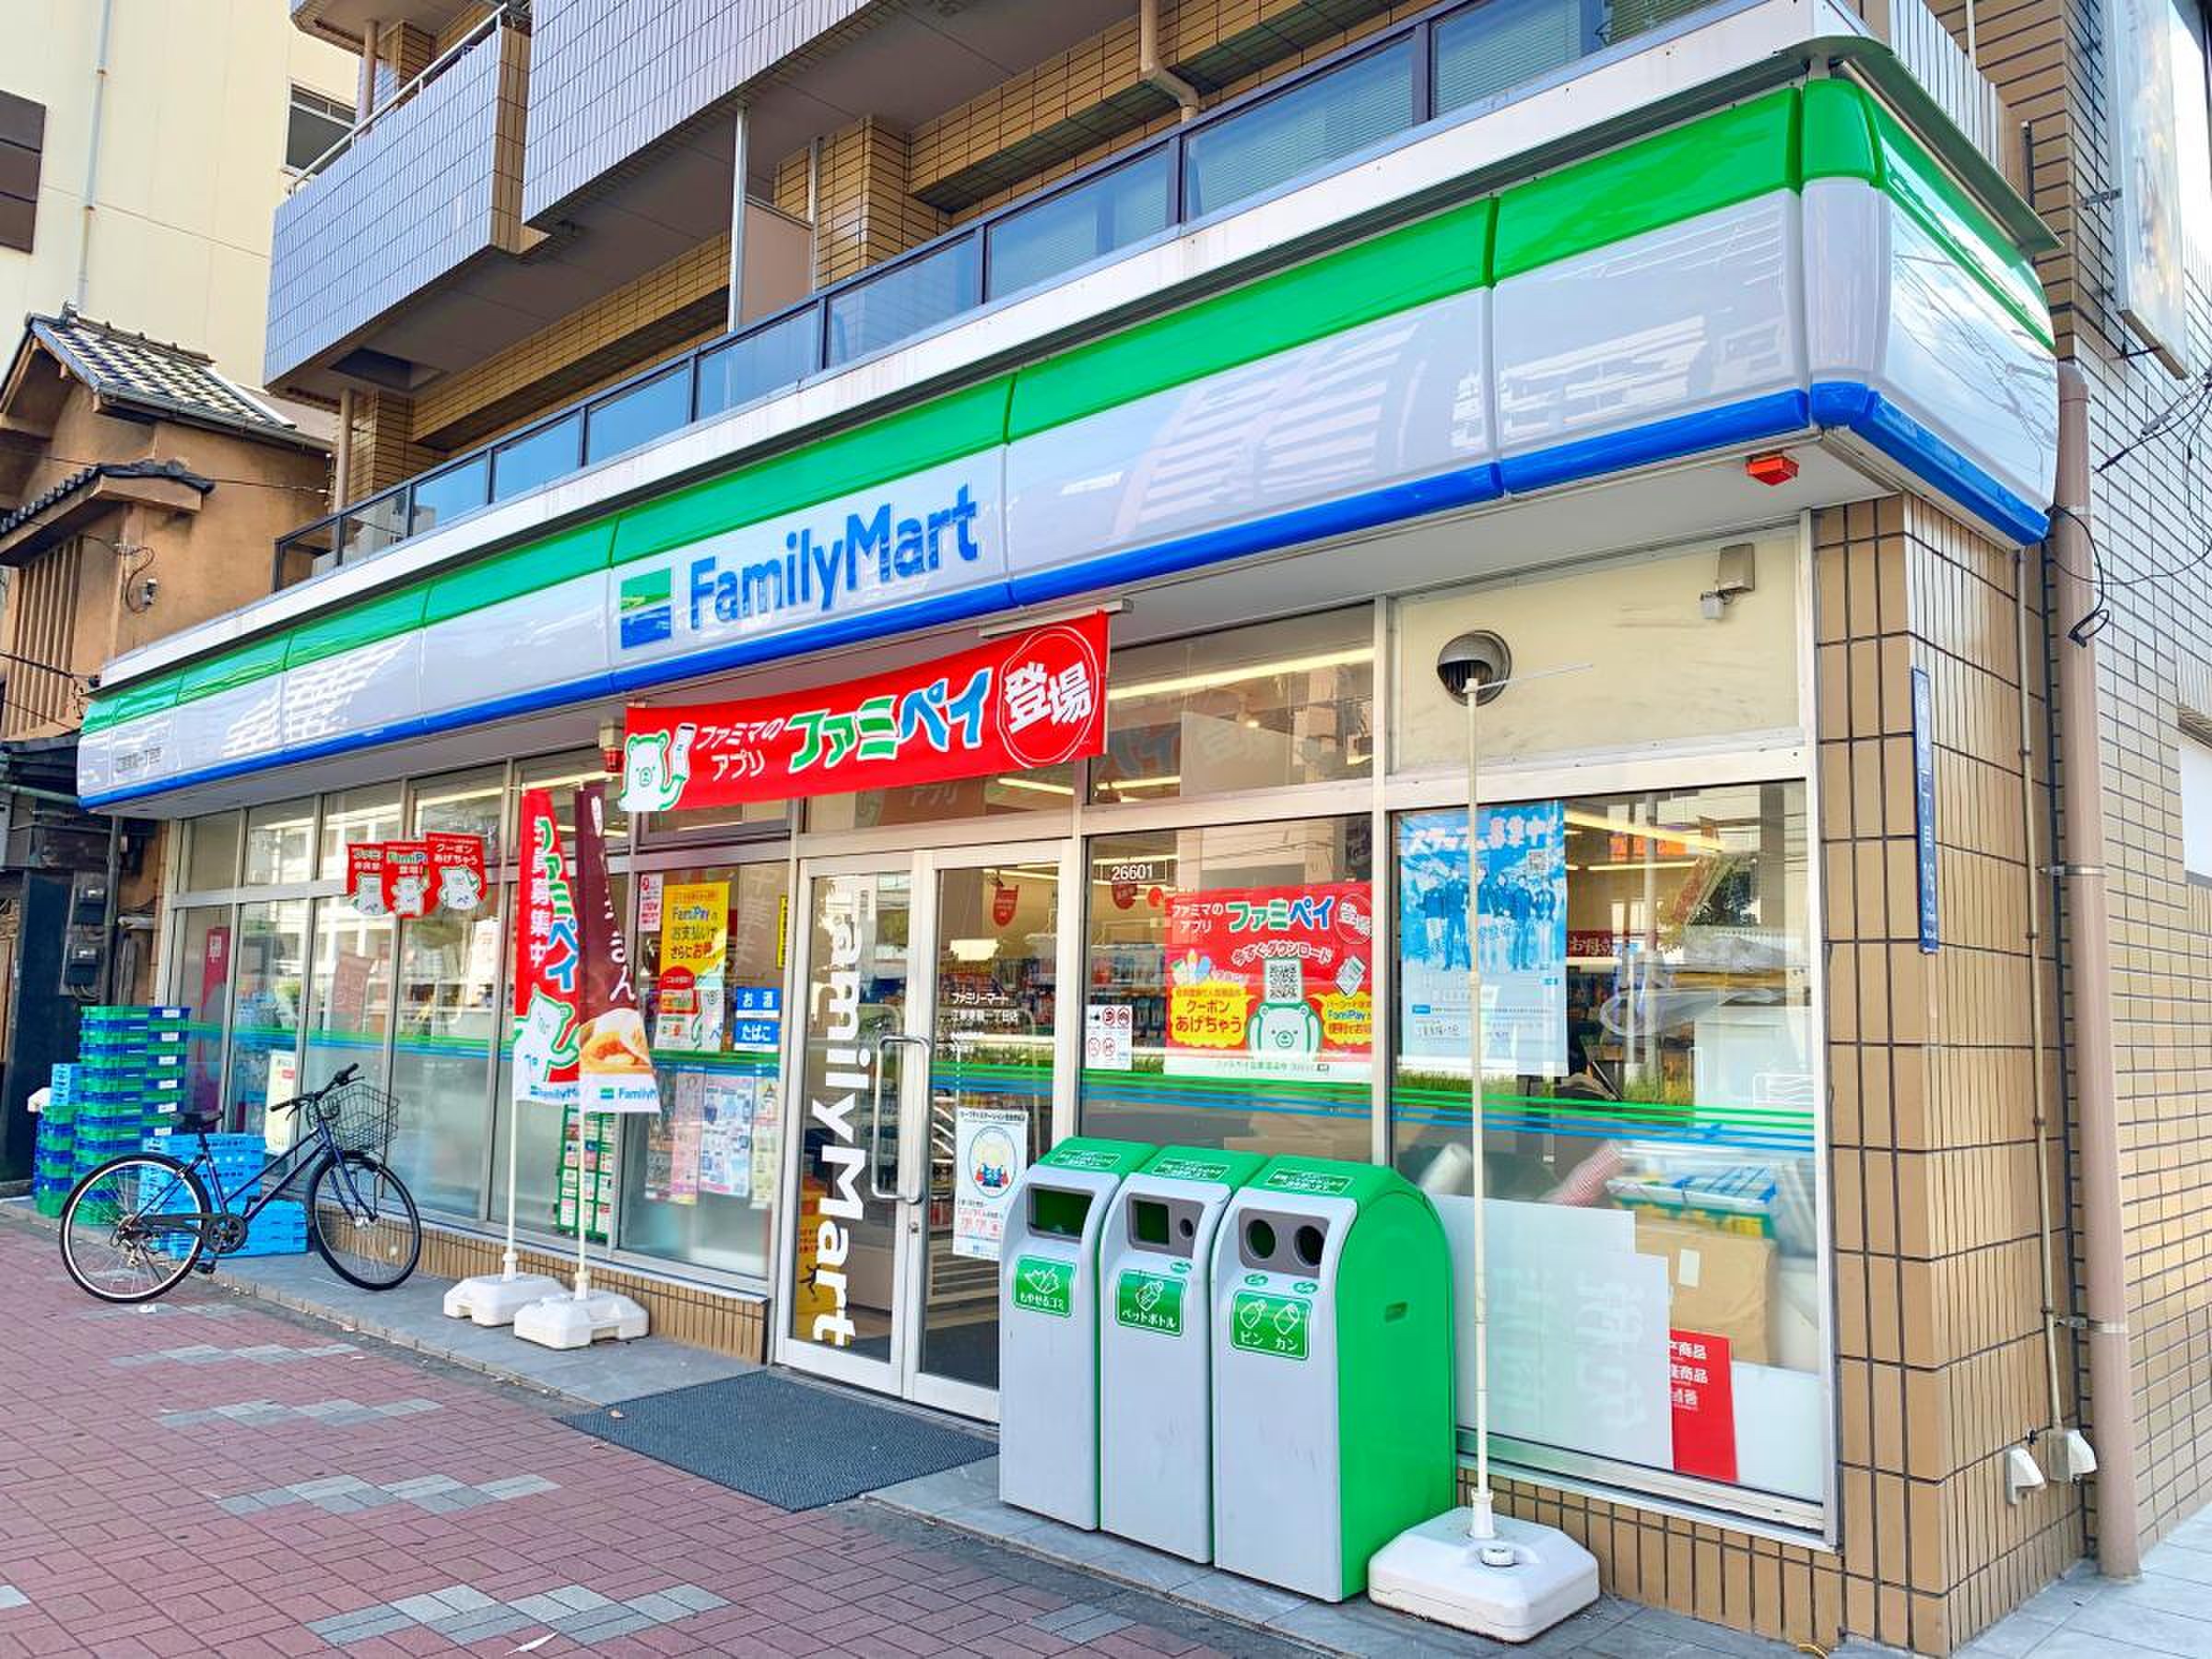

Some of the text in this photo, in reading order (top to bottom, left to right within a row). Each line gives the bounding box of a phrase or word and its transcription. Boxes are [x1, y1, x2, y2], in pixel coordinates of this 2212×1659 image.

[690, 483, 978, 630] FamilyMart
[1003, 660, 1093, 735] 登場
[782, 666, 994, 774] ファミペイ
[696, 717, 785, 749] ファミマの
[712, 749, 765, 782] アプリ
[1112, 865, 1153, 881] 26601
[1171, 903, 1224, 917] ファミマの
[1226, 895, 1335, 931] ファミペイ
[1180, 920, 1211, 933] アプリ
[1230, 939, 1334, 967] 今すぐダウンロード
[950, 991, 1009, 1005] ファミリーマート
[1186, 1000, 1230, 1014] クーポン
[741, 1024, 771, 1041] たばこ
[1175, 1015, 1241, 1033] あげちゃう
[1019, 1291, 1064, 1312] もやせるゴミ
[1121, 1309, 1177, 1329] ペットボトル
[1241, 1331, 1298, 1353] ビン カン
